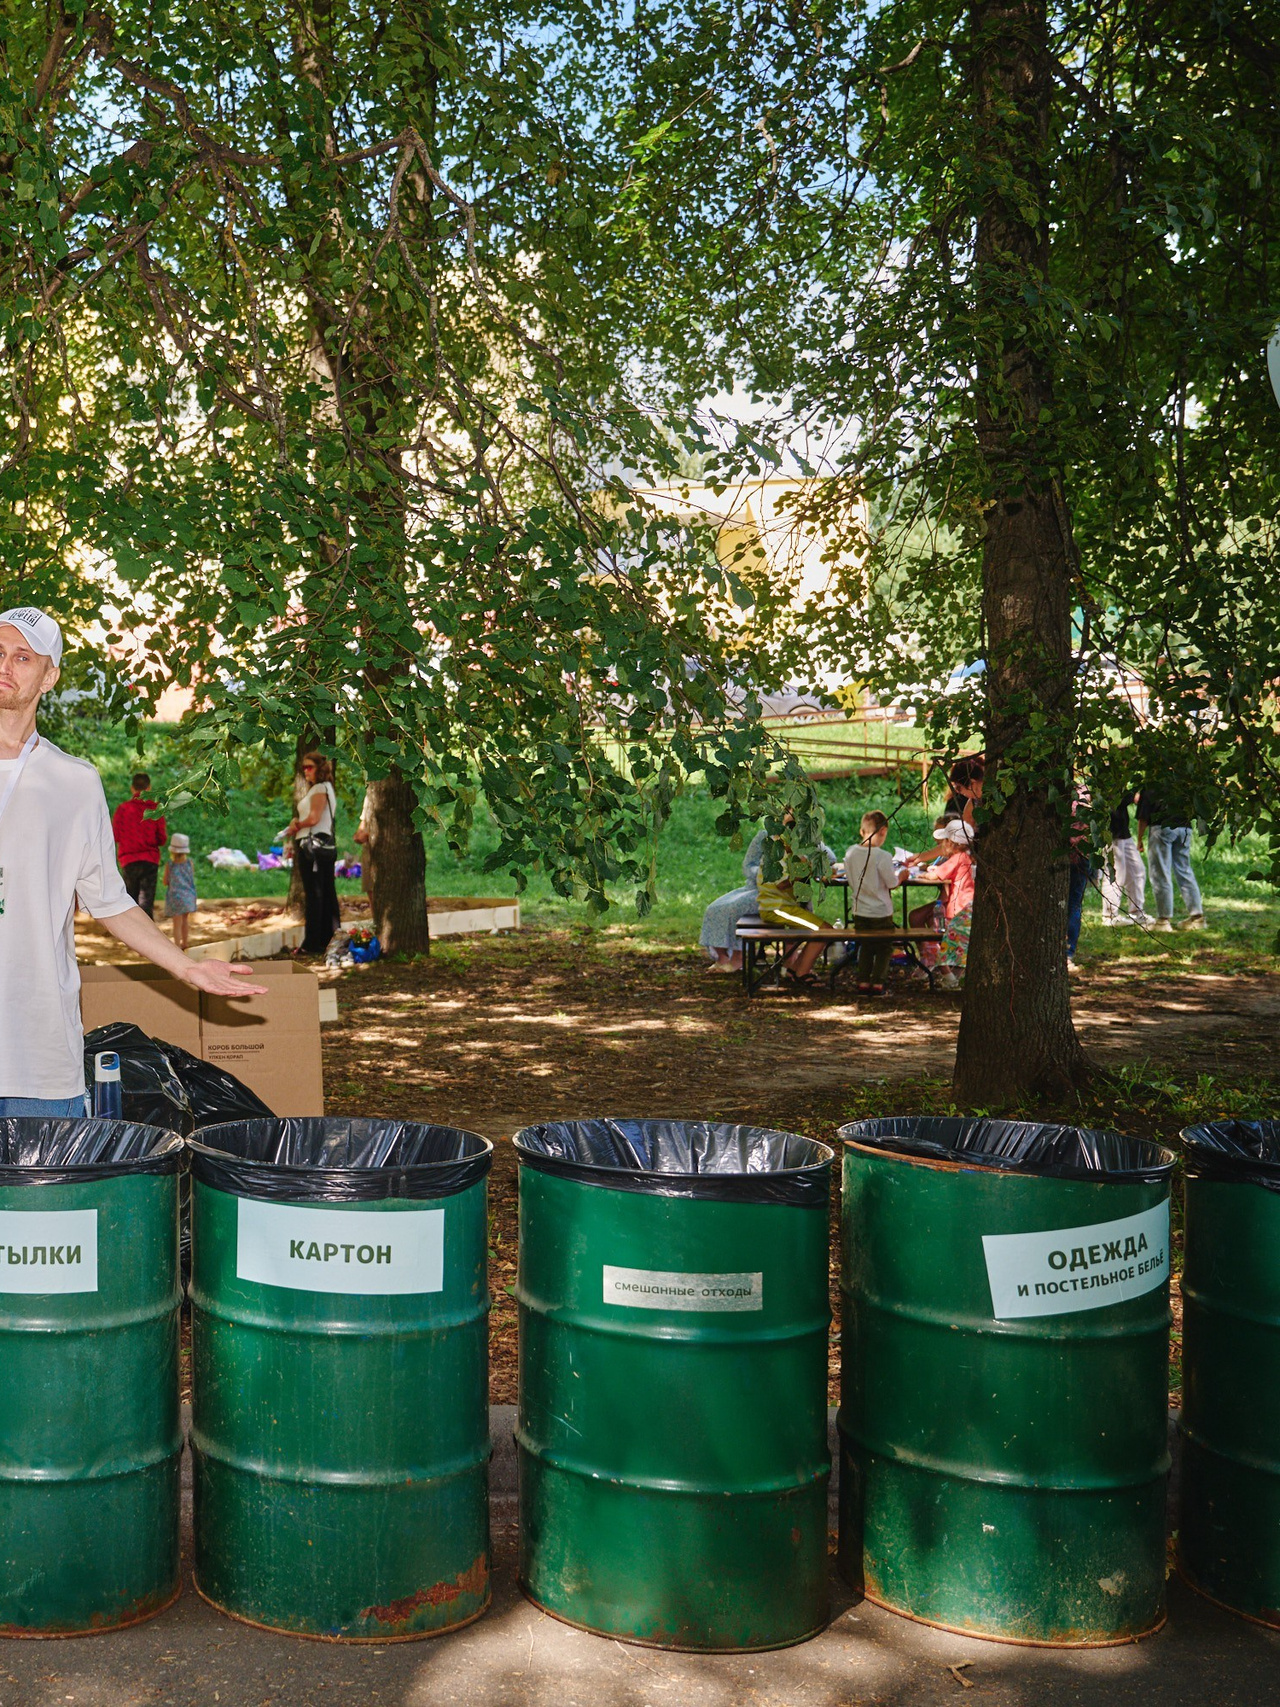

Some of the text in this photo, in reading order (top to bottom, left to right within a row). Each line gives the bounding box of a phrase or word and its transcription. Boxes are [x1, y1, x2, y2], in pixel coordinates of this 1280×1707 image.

[289, 1239, 392, 1264] КАРТОН
[1047, 1232, 1148, 1271] ОДЕЖДА
[1017, 1248, 1164, 1297] И ПОСТЕЛЬНОЕ БЕЛЬЁ
[614, 1280, 752, 1299] смешанные отходы
